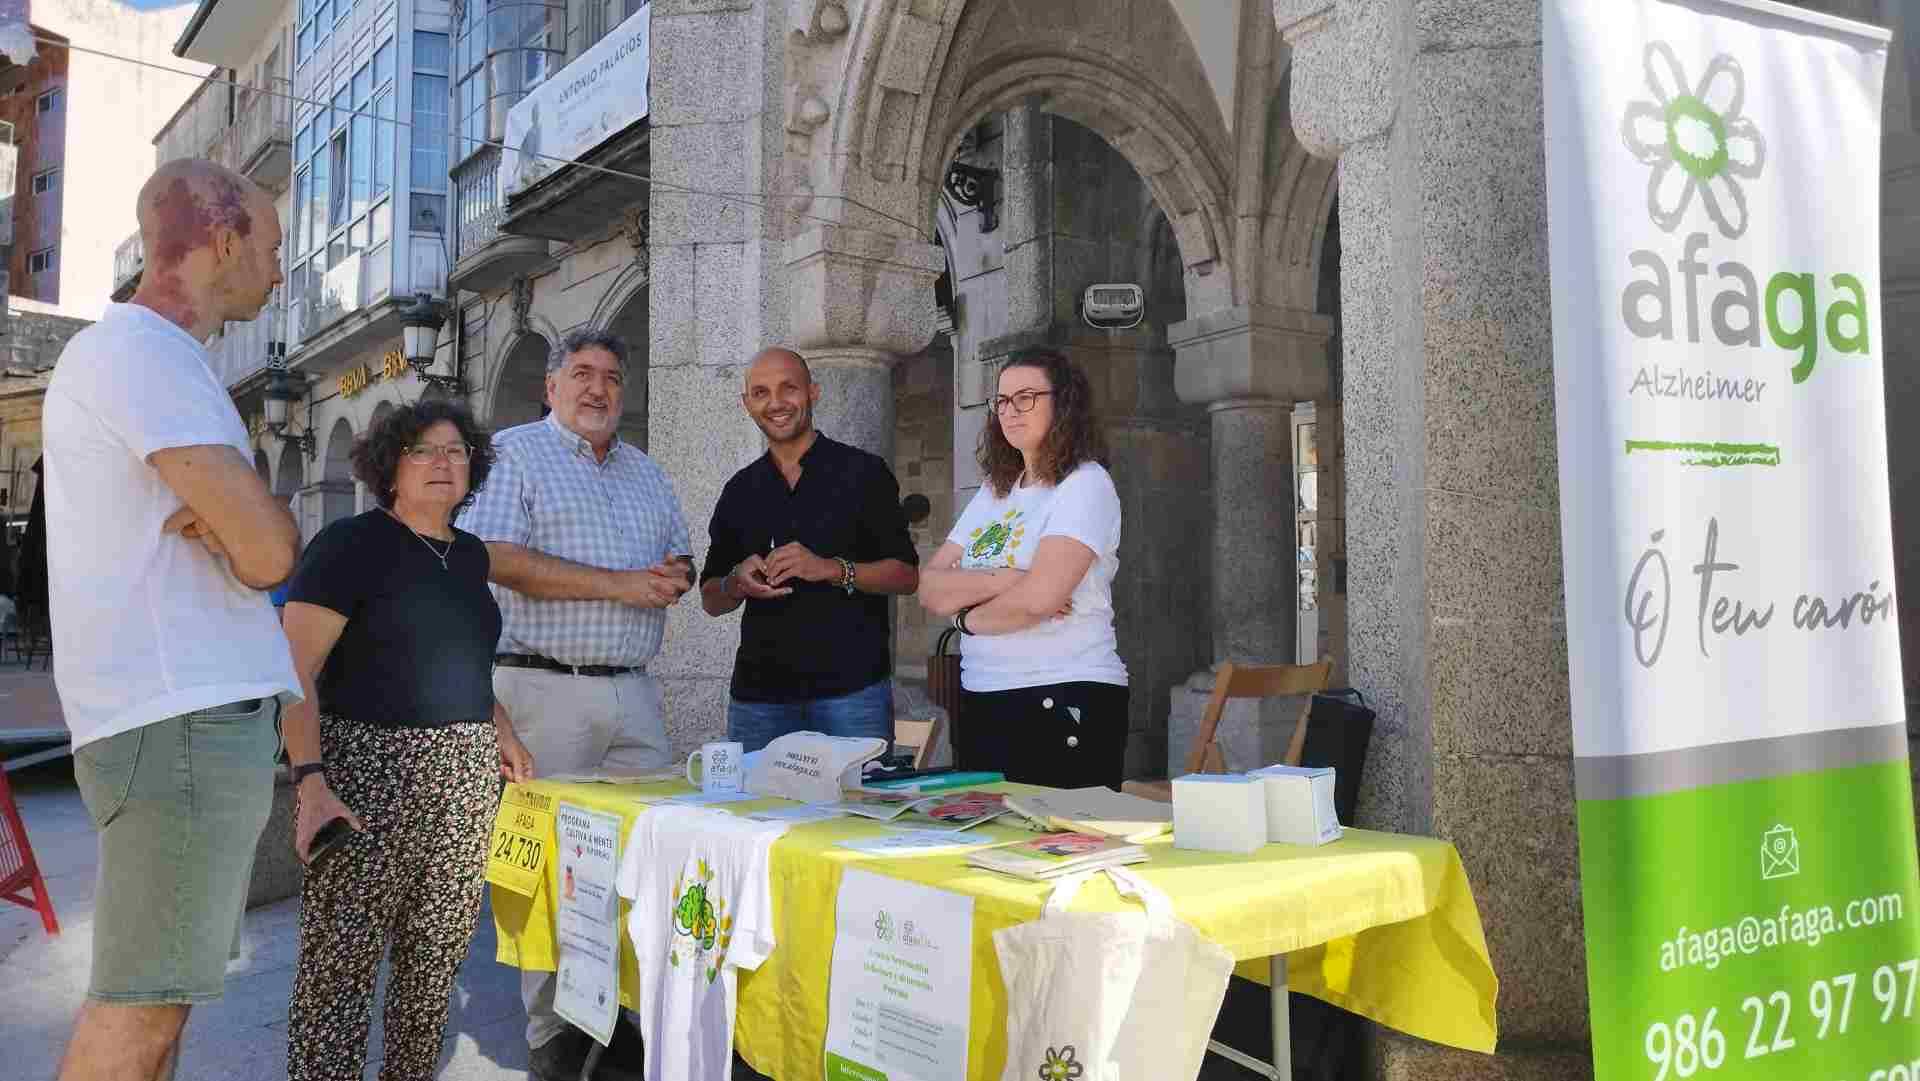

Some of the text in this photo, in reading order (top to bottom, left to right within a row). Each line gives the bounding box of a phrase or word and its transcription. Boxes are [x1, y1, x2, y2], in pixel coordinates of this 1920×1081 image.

[559, 68, 598, 104] ANTONIO
[600, 32, 643, 76] PALACIOS
[1621, 231, 1871, 385] afaga
[339, 350, 409, 398] BBVA BBV
[1629, 364, 1767, 402] Alzheimer
[1625, 528, 1671, 669] Ó
[1691, 516, 1775, 659] teu
[494, 831, 542, 870] 24.730
[513, 811, 536, 830] AFAGA
[1660, 893, 1904, 972] afaga@afaga.com
[1645, 957, 1920, 1081] 986 22 97 97
